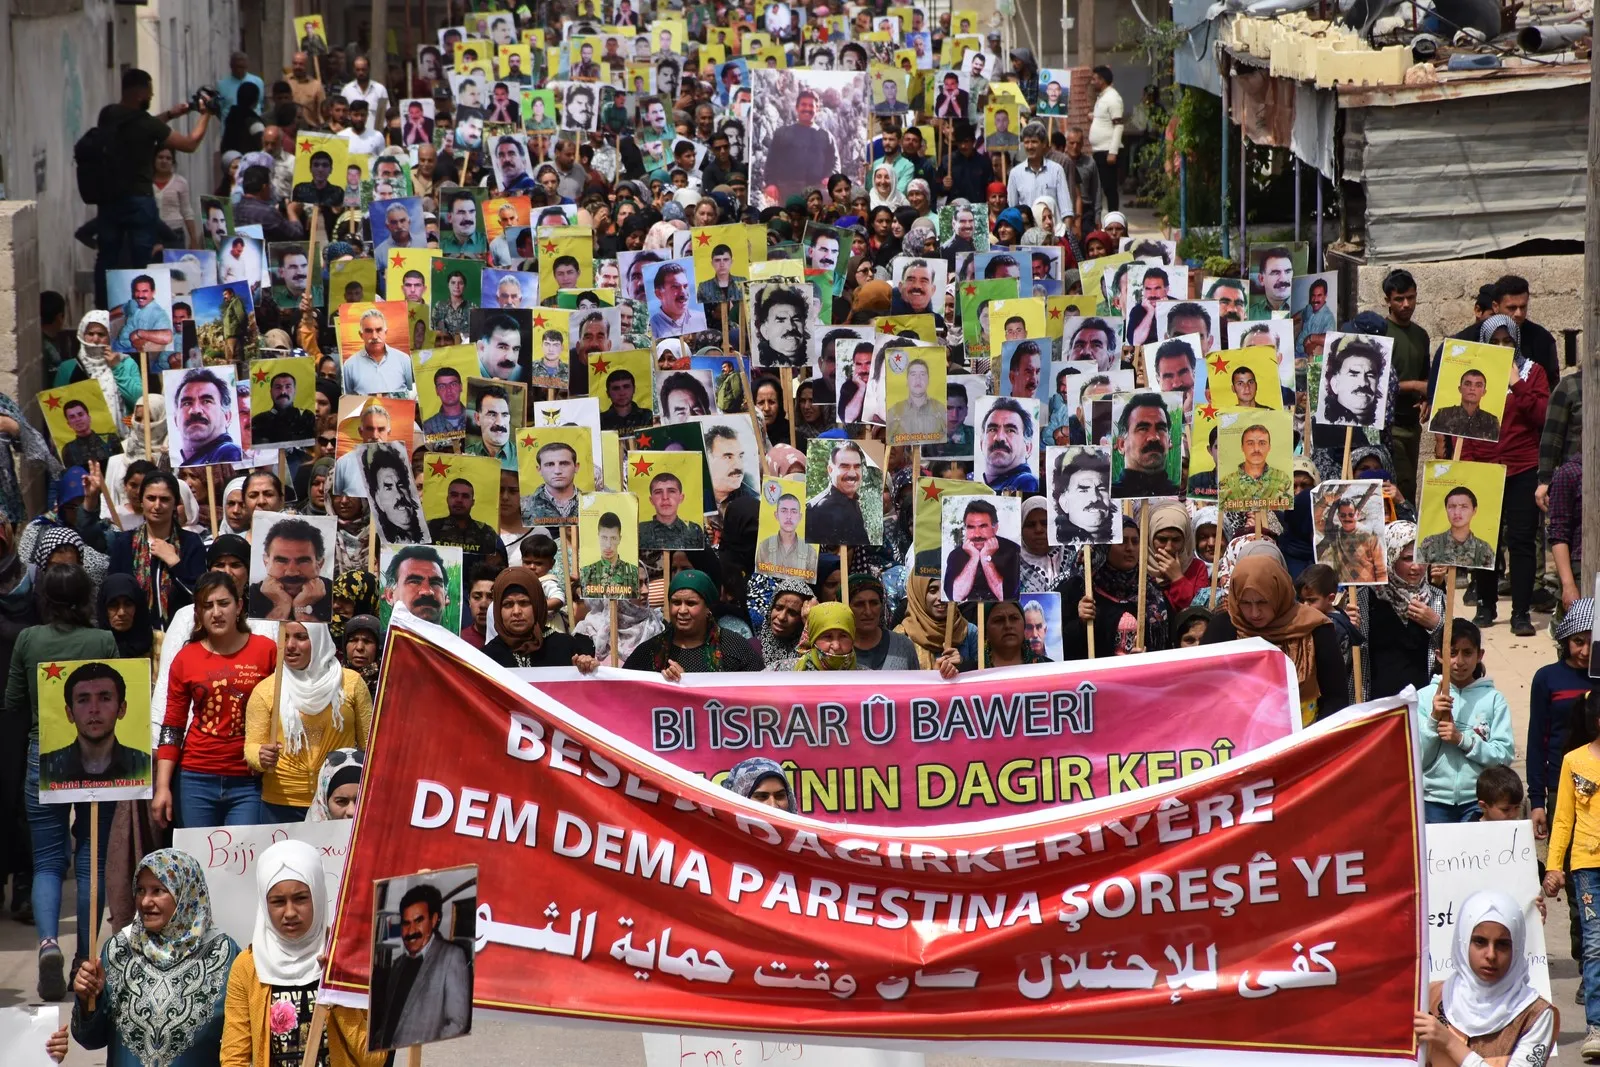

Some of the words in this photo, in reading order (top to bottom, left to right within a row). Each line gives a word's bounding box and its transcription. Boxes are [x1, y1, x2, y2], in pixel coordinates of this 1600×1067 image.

[651, 706, 695, 751] BI
[704, 698, 849, 751] ÎSRAR
[861, 693, 896, 746] Û
[910, 681, 1098, 742] BAWERÎ
[915, 755, 1094, 810] DAGIR
[409, 779, 539, 848] DEM
[552, 808, 713, 897] DEMA
[727, 861, 1043, 933] PARESTINA
[1058, 850, 1280, 933] ŞOREŞÊ
[1292, 850, 1368, 897] YE
[1498, 828, 1530, 865] de
[609, 915, 735, 985] حماية
[1238, 941, 1338, 998] كفى
[753, 959, 858, 1000] وقت
